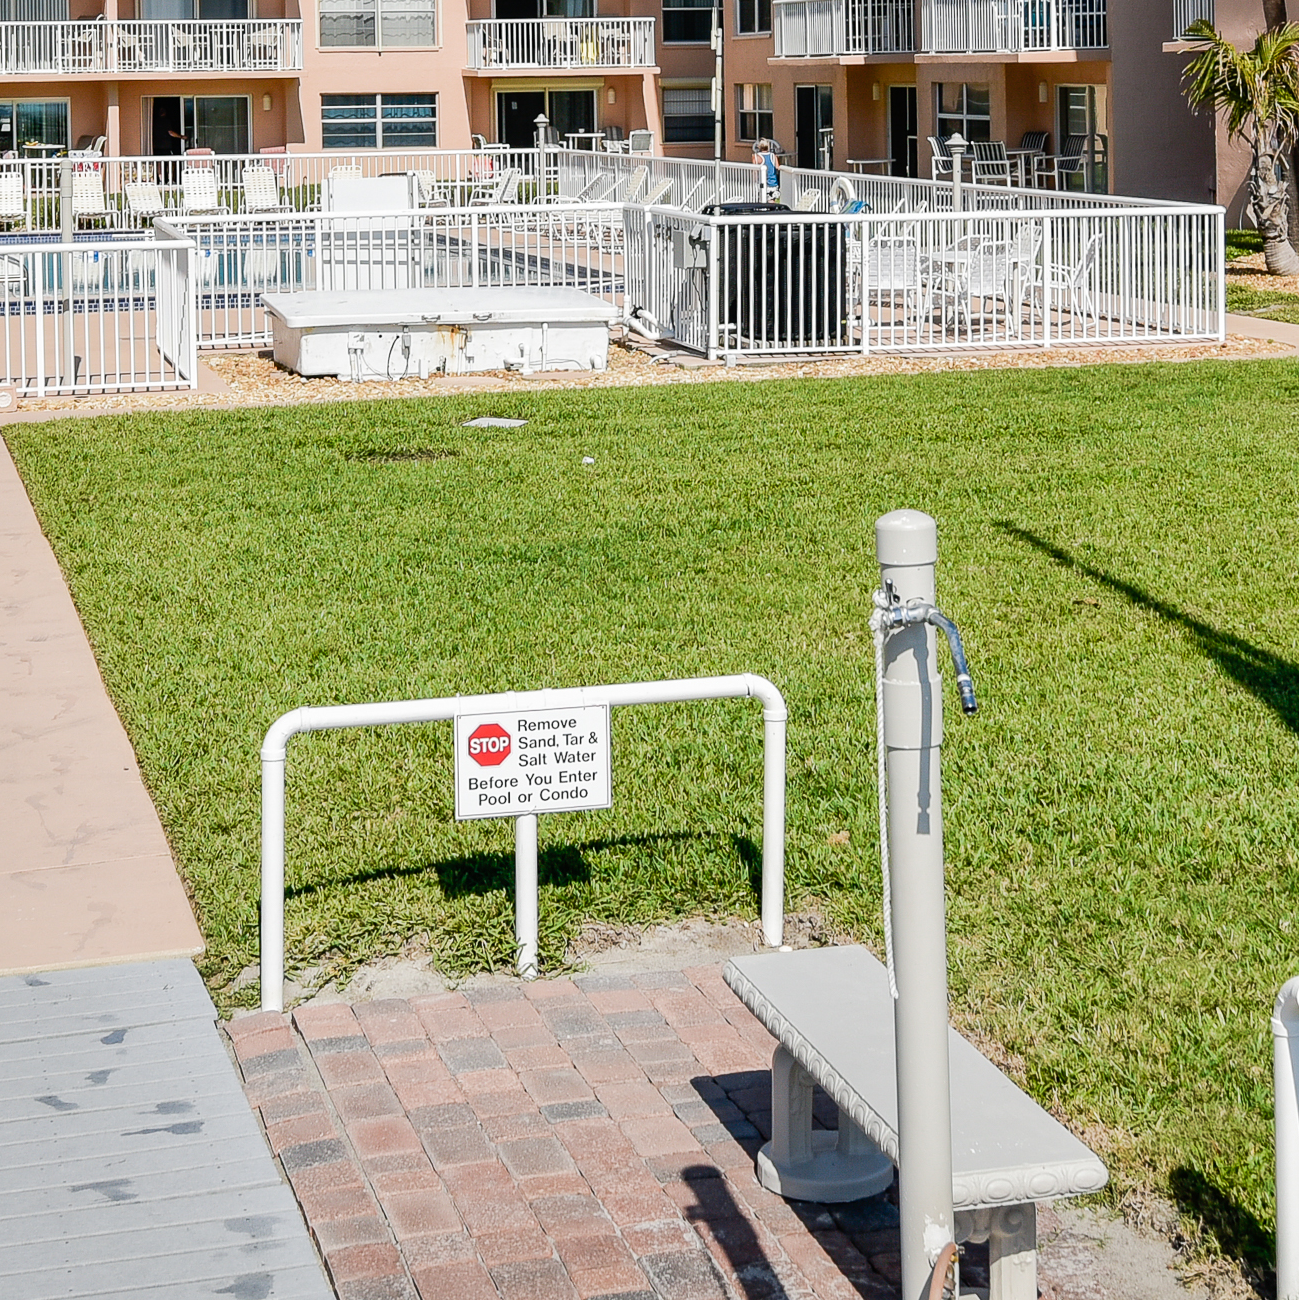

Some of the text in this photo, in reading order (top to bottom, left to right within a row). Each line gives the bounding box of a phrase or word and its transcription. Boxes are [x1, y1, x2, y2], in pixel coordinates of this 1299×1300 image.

[517, 718, 577, 732] Remove
[469, 736, 510, 755] STOP
[518, 731, 598, 749] Sand, Tar &
[518, 751, 596, 767] Salt Water
[468, 770, 597, 790] Before You Enter
[479, 786, 588, 806] Pool or Condo
